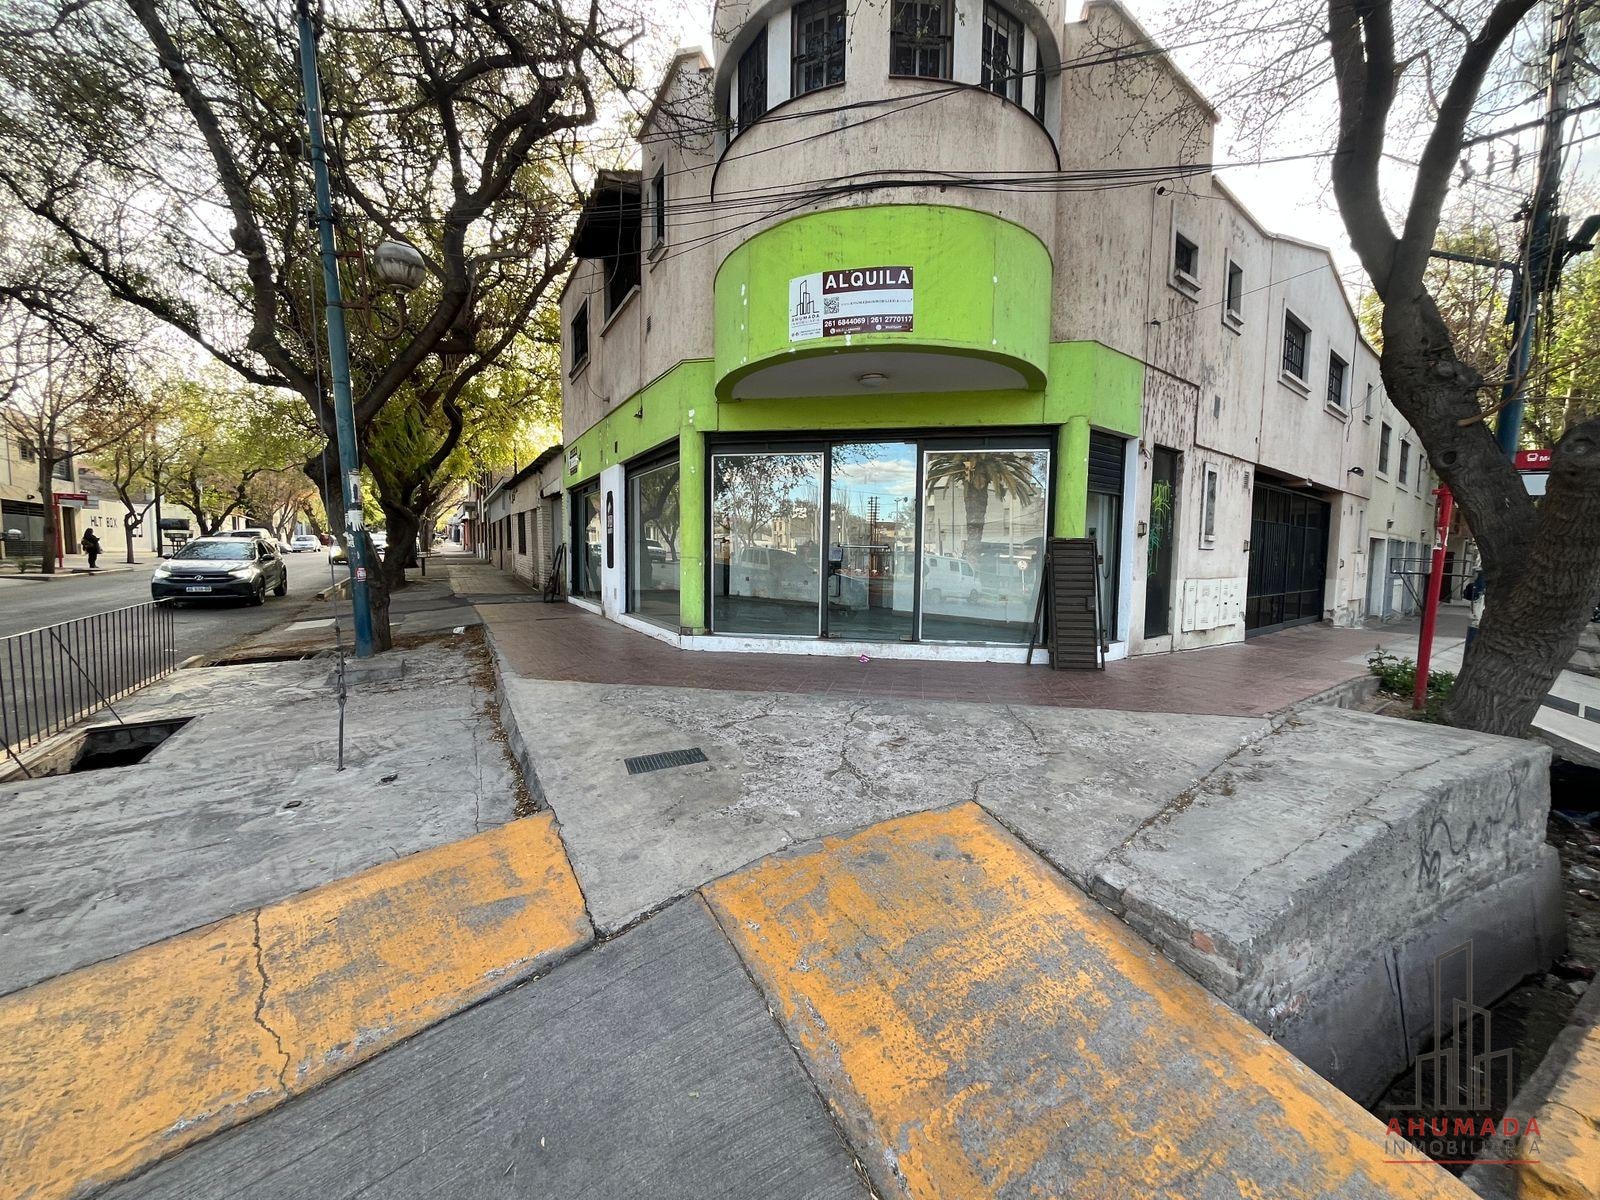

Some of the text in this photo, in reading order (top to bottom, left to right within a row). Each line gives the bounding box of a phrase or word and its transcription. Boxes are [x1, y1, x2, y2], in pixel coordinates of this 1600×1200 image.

[825, 270, 909, 290] ALQUILA
[885, 315, 912, 323] 2770117
[106, 516, 118, 529] BOX
